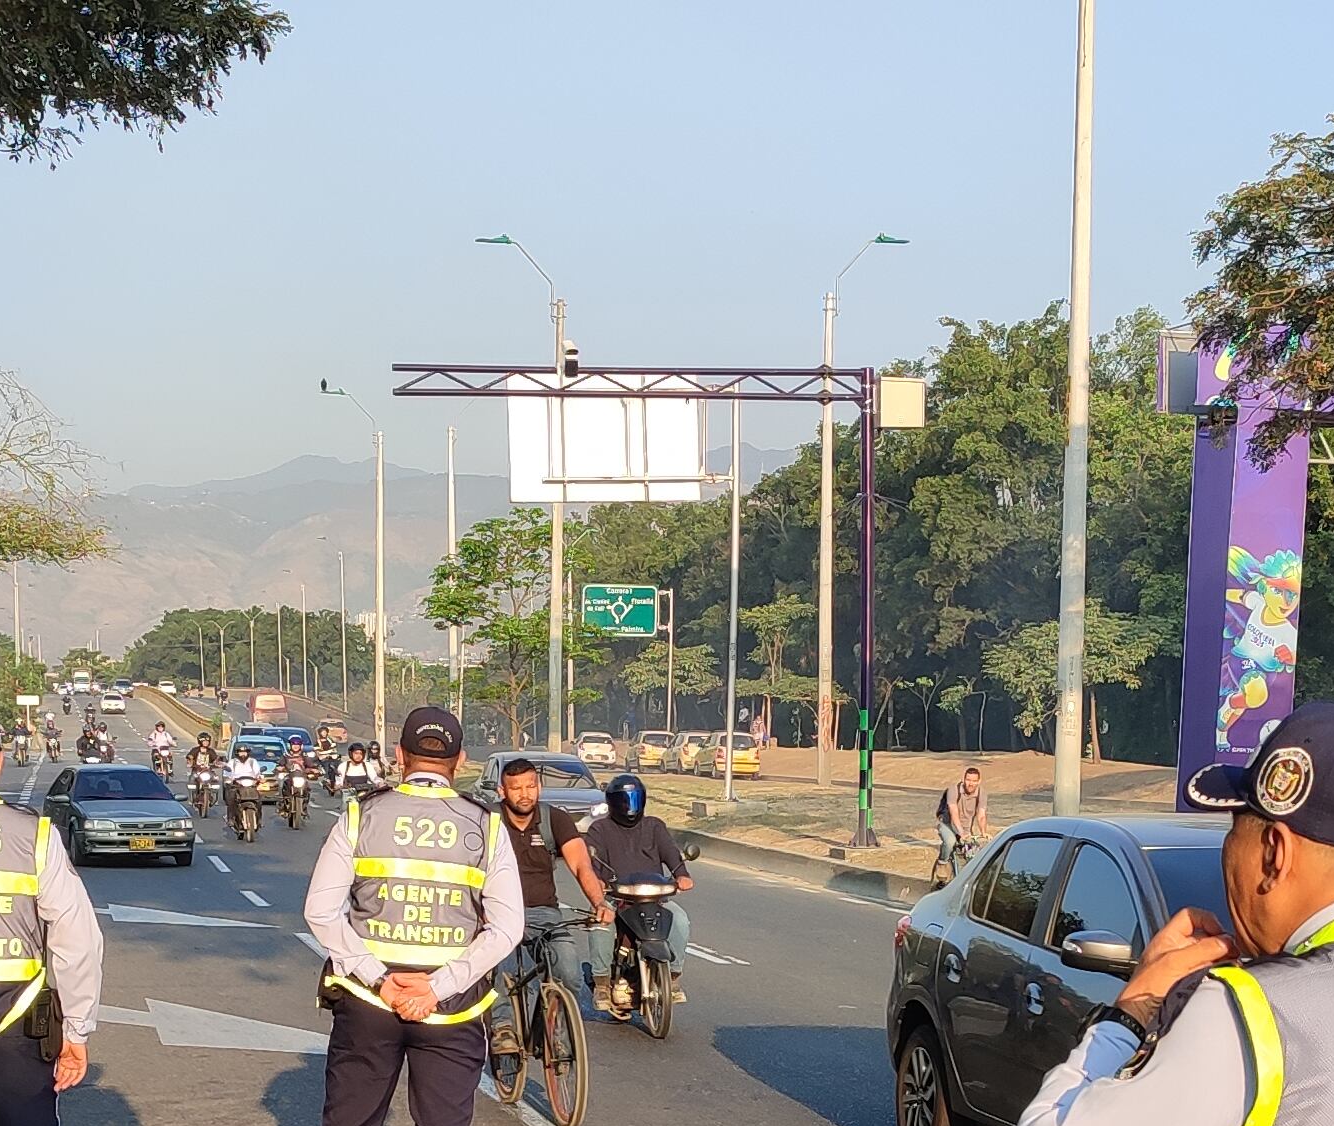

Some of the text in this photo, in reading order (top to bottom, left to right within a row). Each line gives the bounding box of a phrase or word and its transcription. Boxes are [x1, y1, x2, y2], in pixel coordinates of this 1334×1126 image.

[393, 816, 458, 849] 529
[377, 883, 462, 907] AGENTE
[403, 904, 432, 923] DE
[366, 919, 465, 944] TRANSITO
